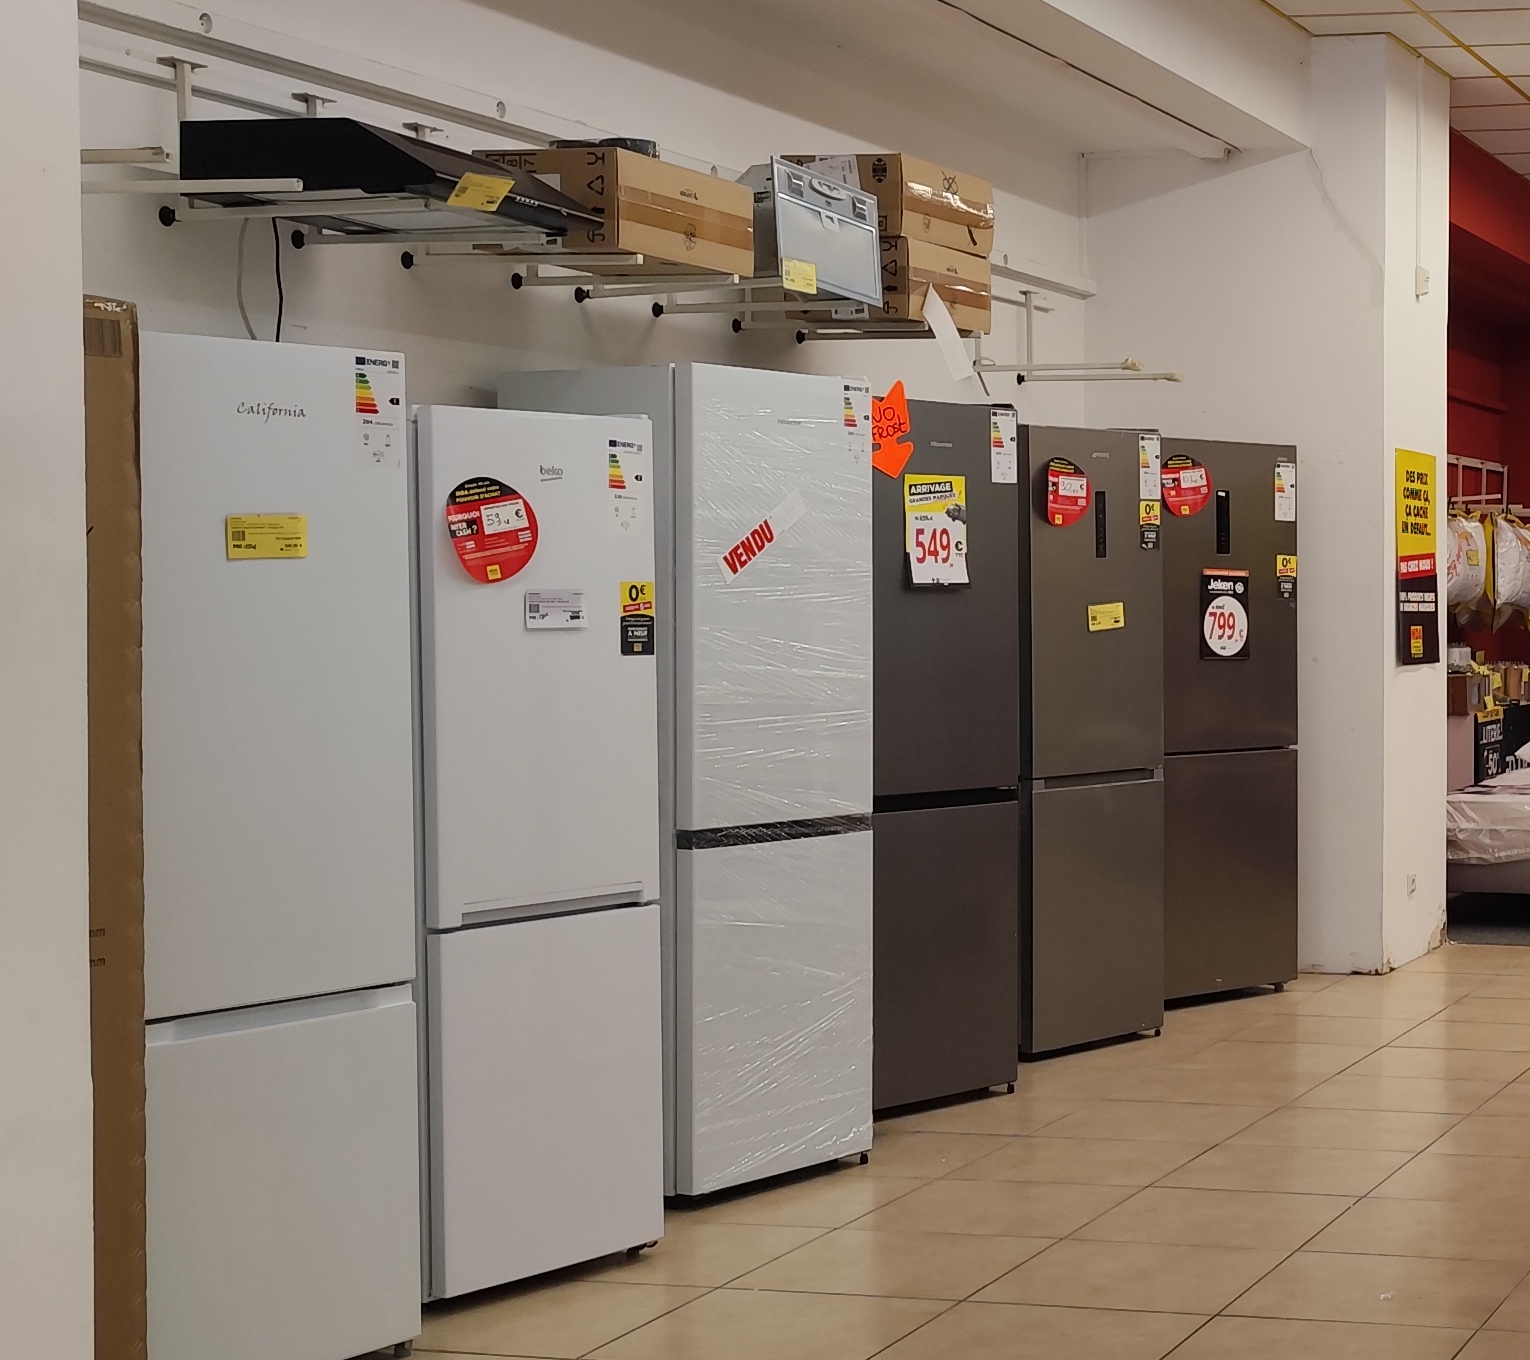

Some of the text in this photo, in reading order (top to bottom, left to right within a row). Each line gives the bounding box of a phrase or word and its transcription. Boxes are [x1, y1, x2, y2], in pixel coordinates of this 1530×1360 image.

[236, 402, 307, 424] California
[539, 464, 564, 477] beko
[910, 483, 952, 494] ARRIVAGE
[514, 509, 524, 519] €
[723, 518, 775, 575] VENDU
[915, 527, 951, 564] 549
[1207, 578, 1234, 591] Jeken
[1209, 611, 1236, 641] 799
